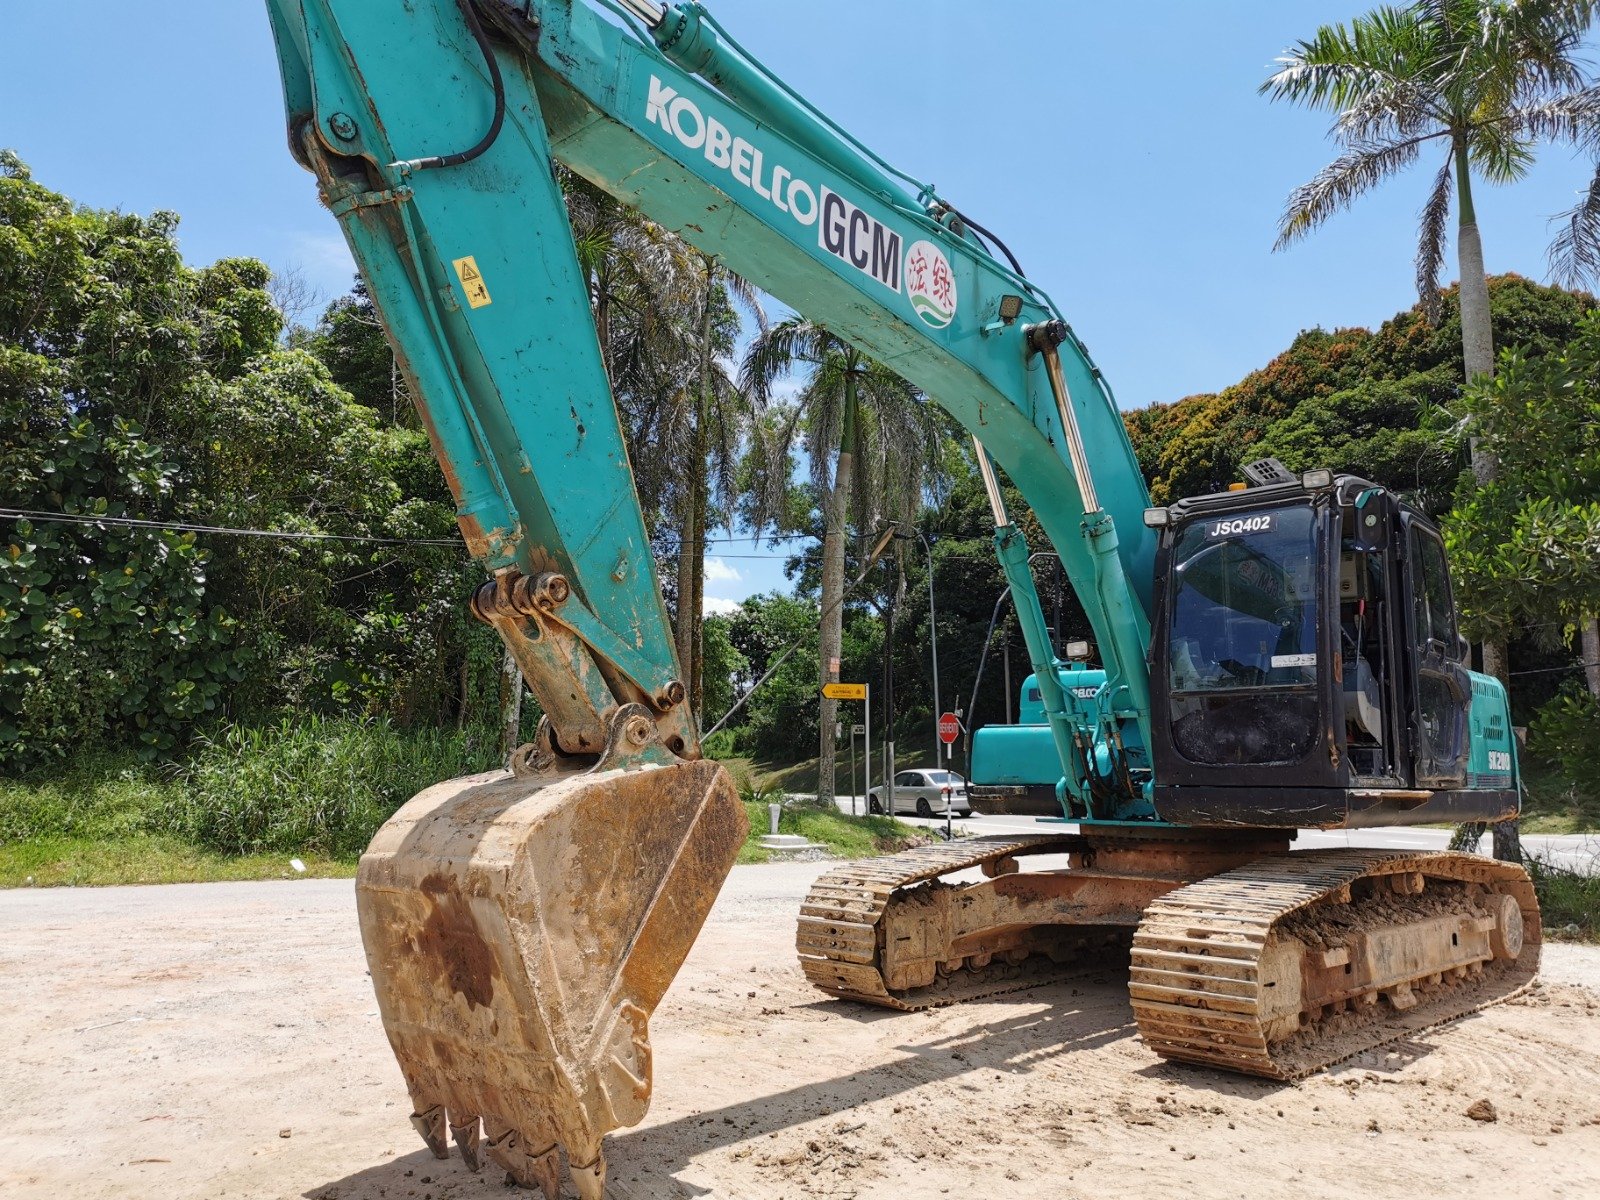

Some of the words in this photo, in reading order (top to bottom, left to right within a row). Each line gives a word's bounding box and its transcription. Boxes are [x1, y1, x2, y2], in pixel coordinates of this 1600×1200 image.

[645, 74, 818, 226] KOBELCO
[823, 192, 900, 289] GCM
[1211, 516, 1271, 537] JSQ402
[1490, 752, 1510, 770] SK200
